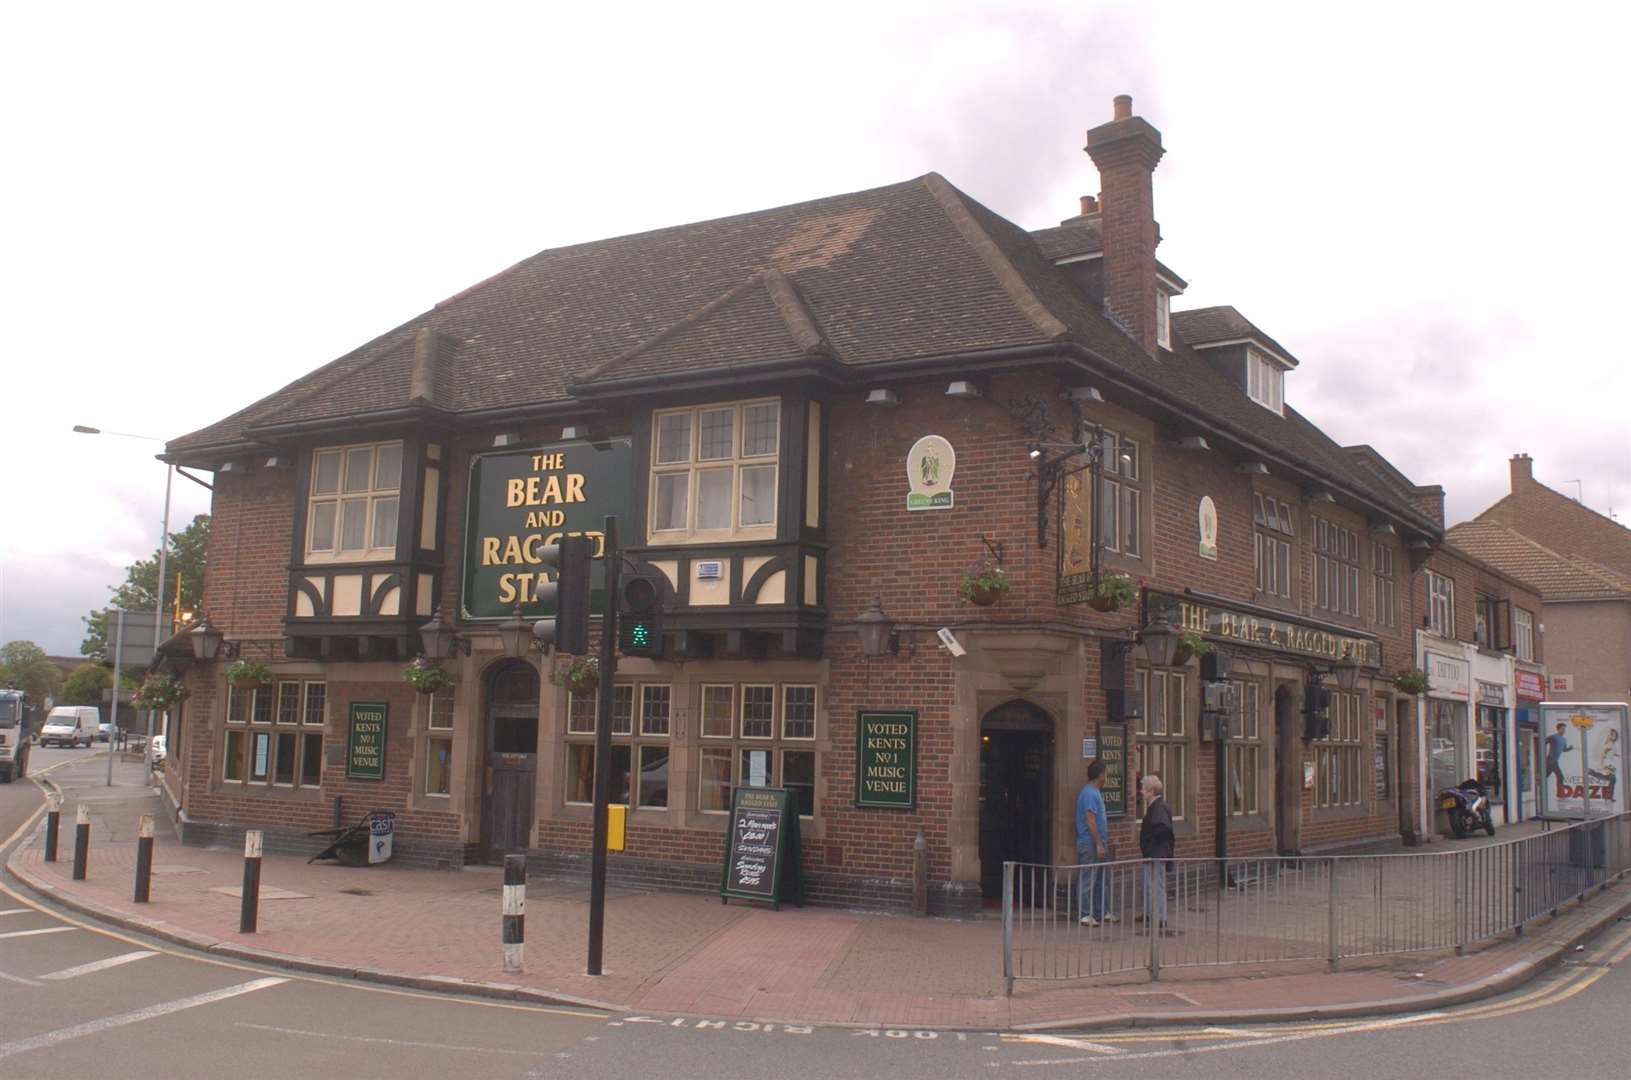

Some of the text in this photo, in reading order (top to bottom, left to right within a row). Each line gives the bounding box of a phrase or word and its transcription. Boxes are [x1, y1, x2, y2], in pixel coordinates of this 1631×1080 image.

[532, 453, 565, 471] THE
[506, 473, 586, 507] BEAR
[525, 510, 566, 528] AND
[482, 531, 606, 566] RAGD
[1179, 602, 1210, 632] THE
[1221, 613, 1260, 642] BEAR
[1269, 622, 1281, 645] &
[1286, 625, 1337, 656] RAGGED
[355, 711, 382, 721] VOTED
[355, 723, 381, 732] KENTS
[867, 724, 907, 735] VOTED
[868, 738, 906, 749] KENTS
[1102, 736, 1121, 746] VOTED
[355, 746, 379, 755] MUSIC
[1102, 751, 1121, 760] KENTS
[353, 757, 379, 767] VENUE
[867, 766, 905, 778] MUSIC
[865, 781, 907, 793] VENUE
[1557, 785, 1612, 800] DAZE
